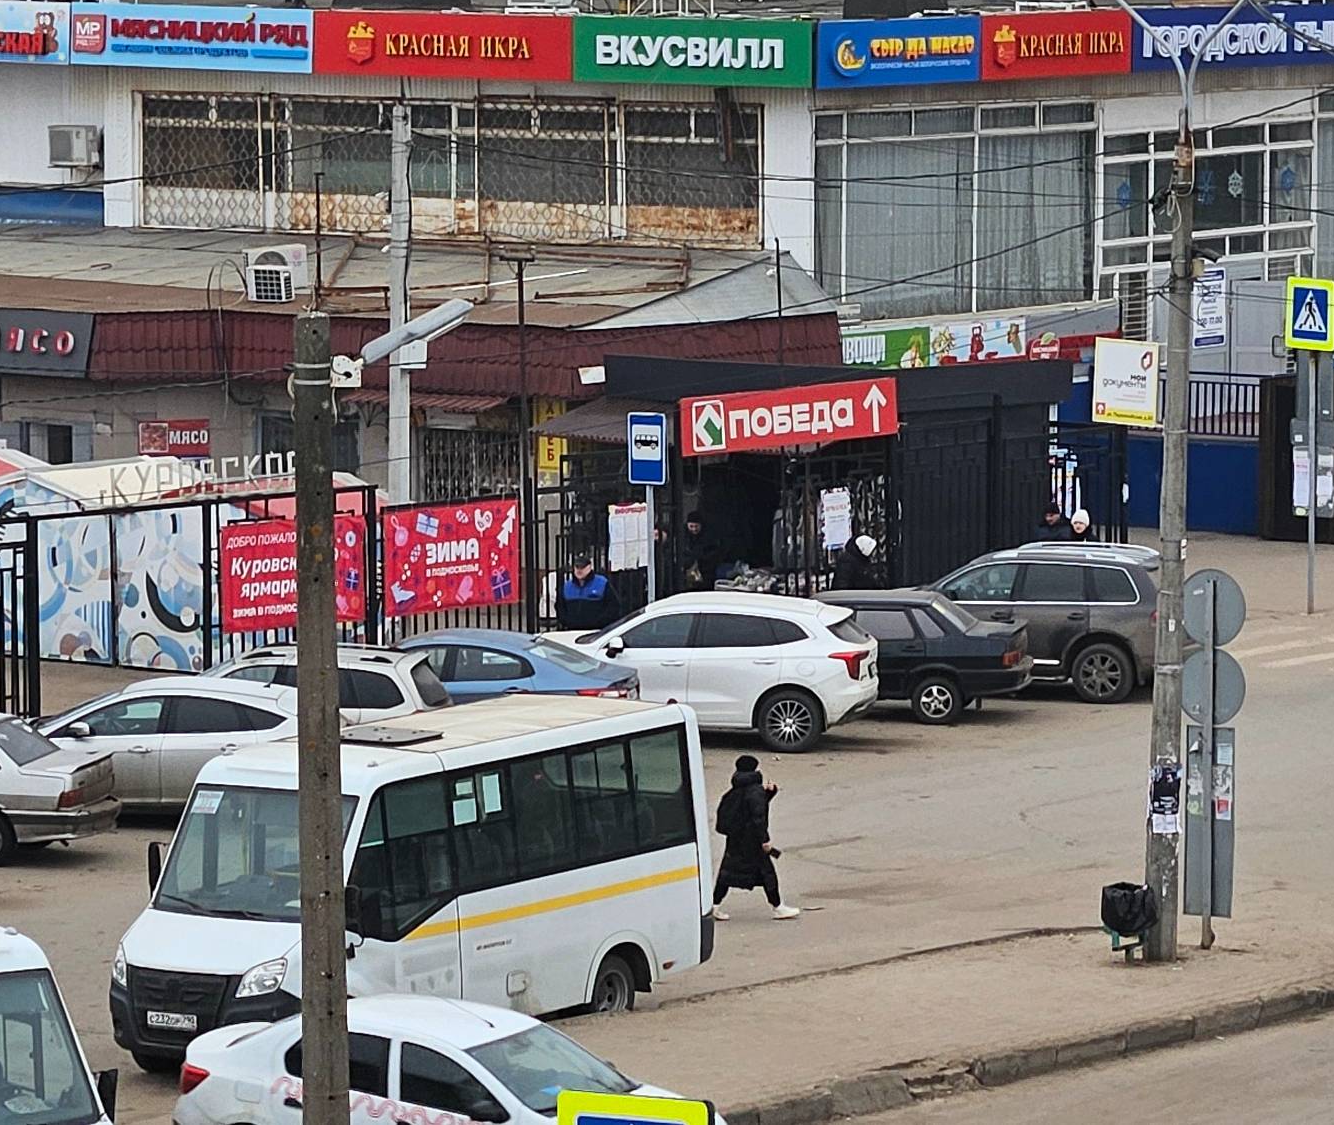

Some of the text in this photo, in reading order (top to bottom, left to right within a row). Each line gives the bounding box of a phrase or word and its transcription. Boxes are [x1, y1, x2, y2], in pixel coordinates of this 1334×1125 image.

[111, 13, 255, 44] МЯСНИЦКИЙ
[260, 23, 308, 48] РЯД
[1019, 30, 1124, 57] КРАСНАЯ ИКРА
[1142, 12, 1287, 62] ГОРОДСКОЙ
[385, 33, 531, 59] КРАСНАЯ ИКРА
[596, 34, 784, 70] ВКУСВИЛЛ
[870, 34, 975, 60] СЫР ДА МАСЛО
[728, 397, 855, 440] ПОБЕДА
[169, 429, 209, 446] МЯСО
[226, 531, 297, 550] ДОБРО ПОЖАЛО
[426, 537, 479, 565] ЗИМА
[266, 603, 297, 615] ПОДМОС
